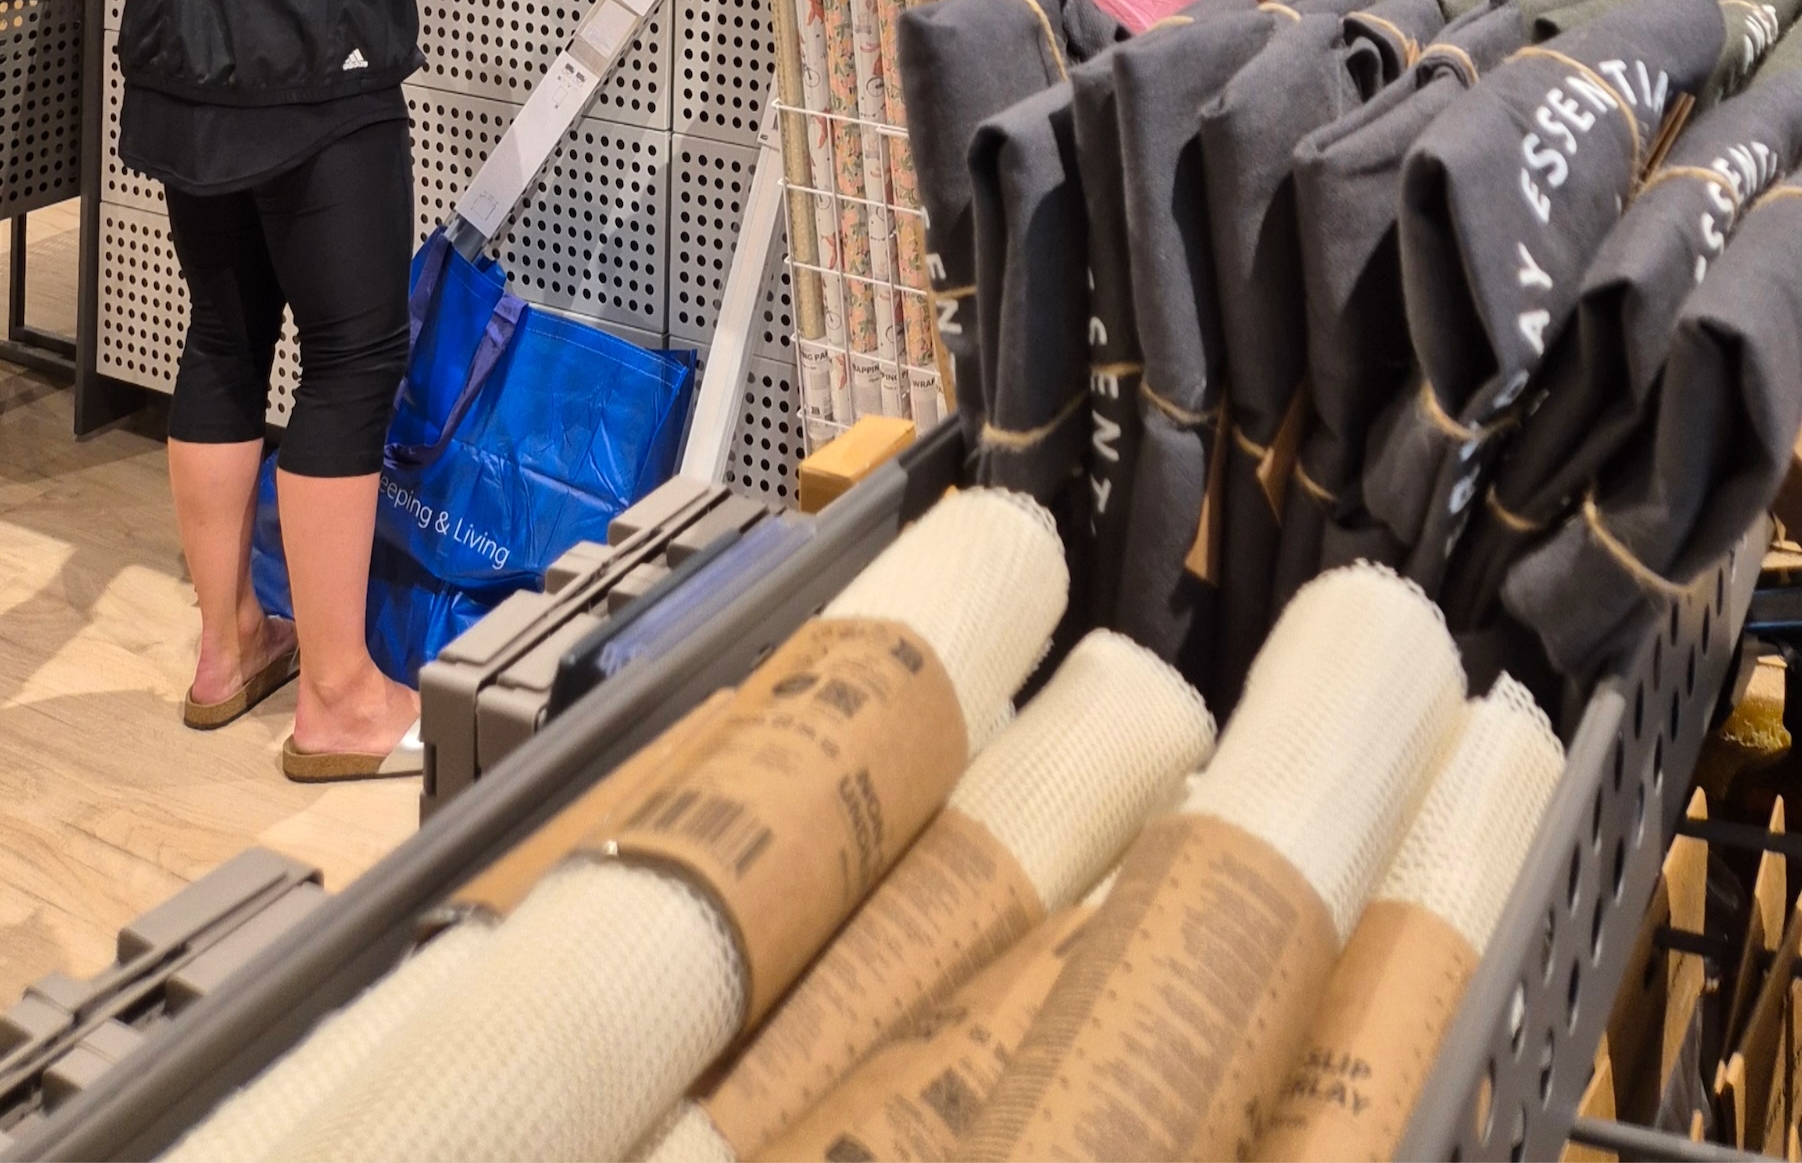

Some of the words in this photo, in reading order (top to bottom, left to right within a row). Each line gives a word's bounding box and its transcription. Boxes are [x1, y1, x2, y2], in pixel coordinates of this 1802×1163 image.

[380, 475, 433, 529] eeping
[434, 510, 451, 536] &
[453, 517, 511, 570] Living
